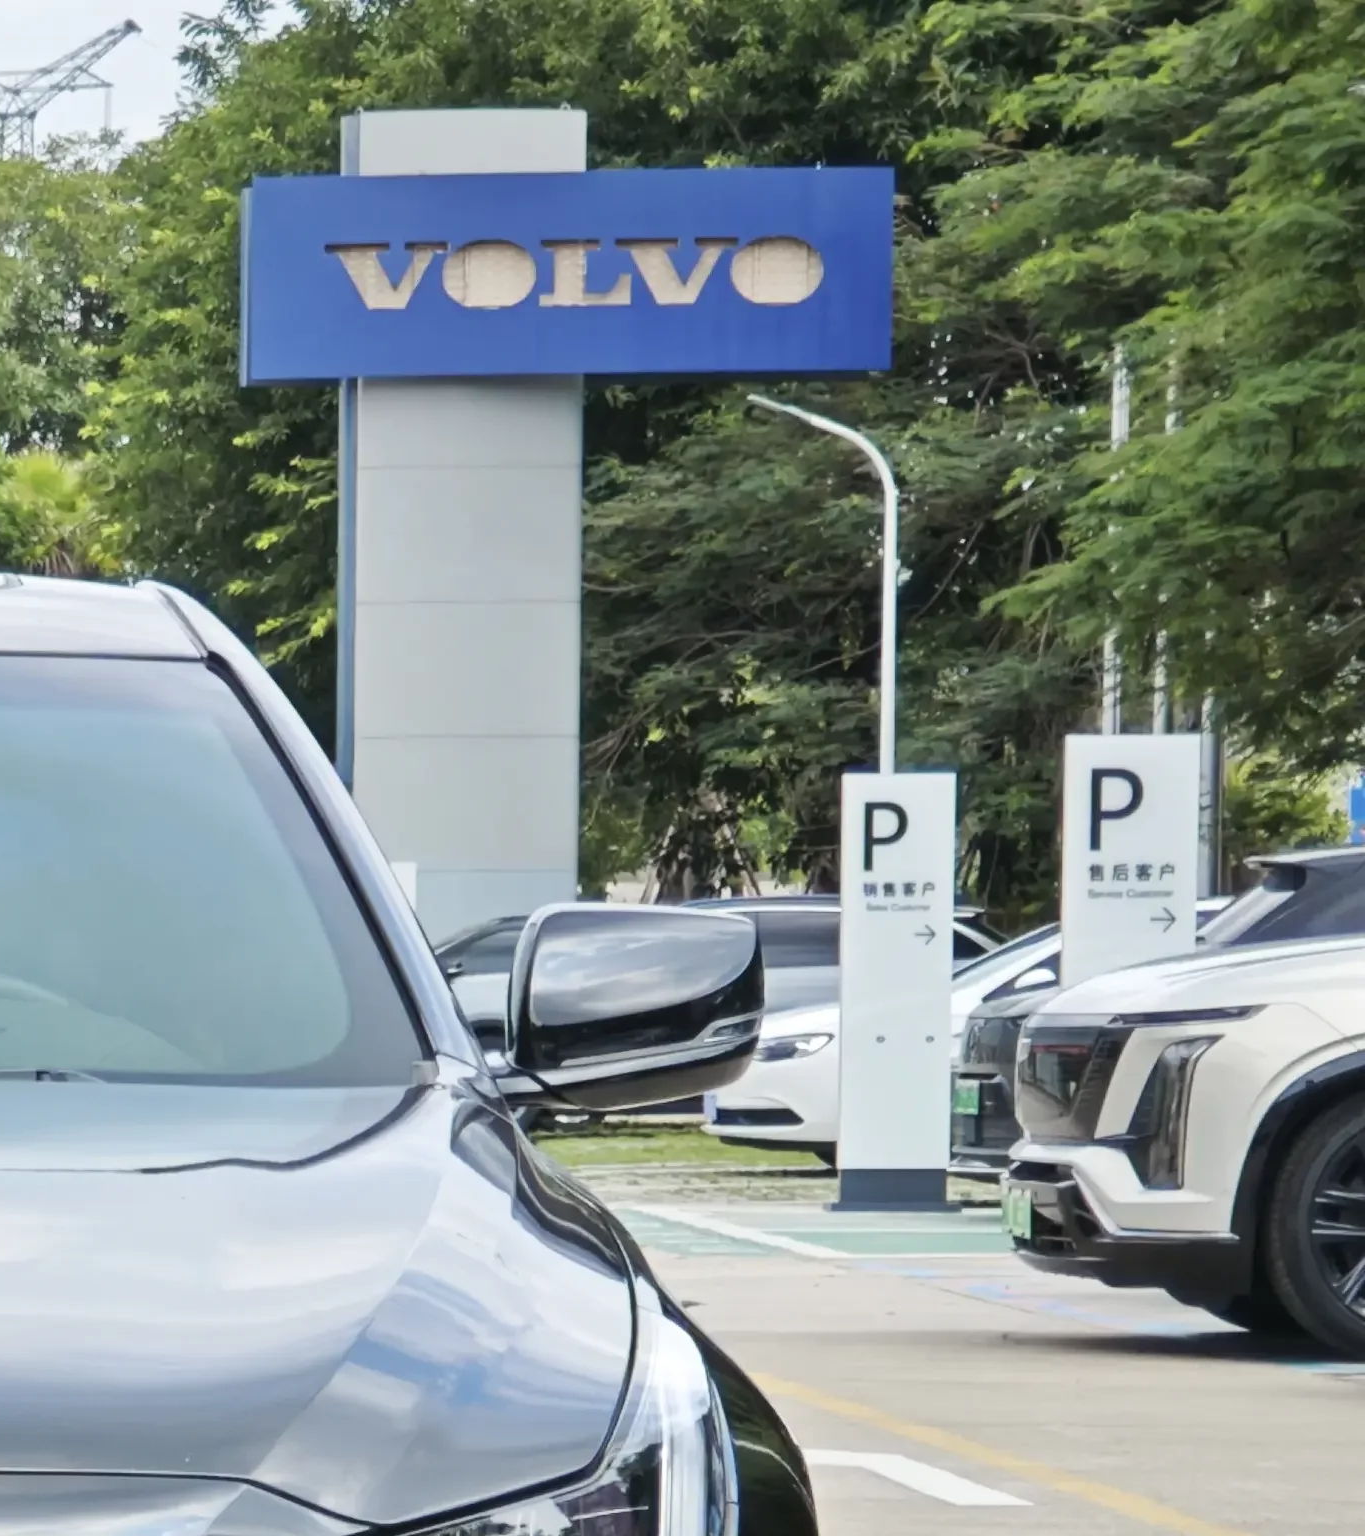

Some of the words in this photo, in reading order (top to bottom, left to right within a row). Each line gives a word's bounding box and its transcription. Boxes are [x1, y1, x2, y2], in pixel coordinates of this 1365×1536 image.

[324, 236, 824, 310] VOLVO
[863, 802, 908, 872] P
[1089, 768, 1144, 851] P
[863, 881, 936, 898] 销售客户
[1088, 863, 1176, 882] 售后客户
